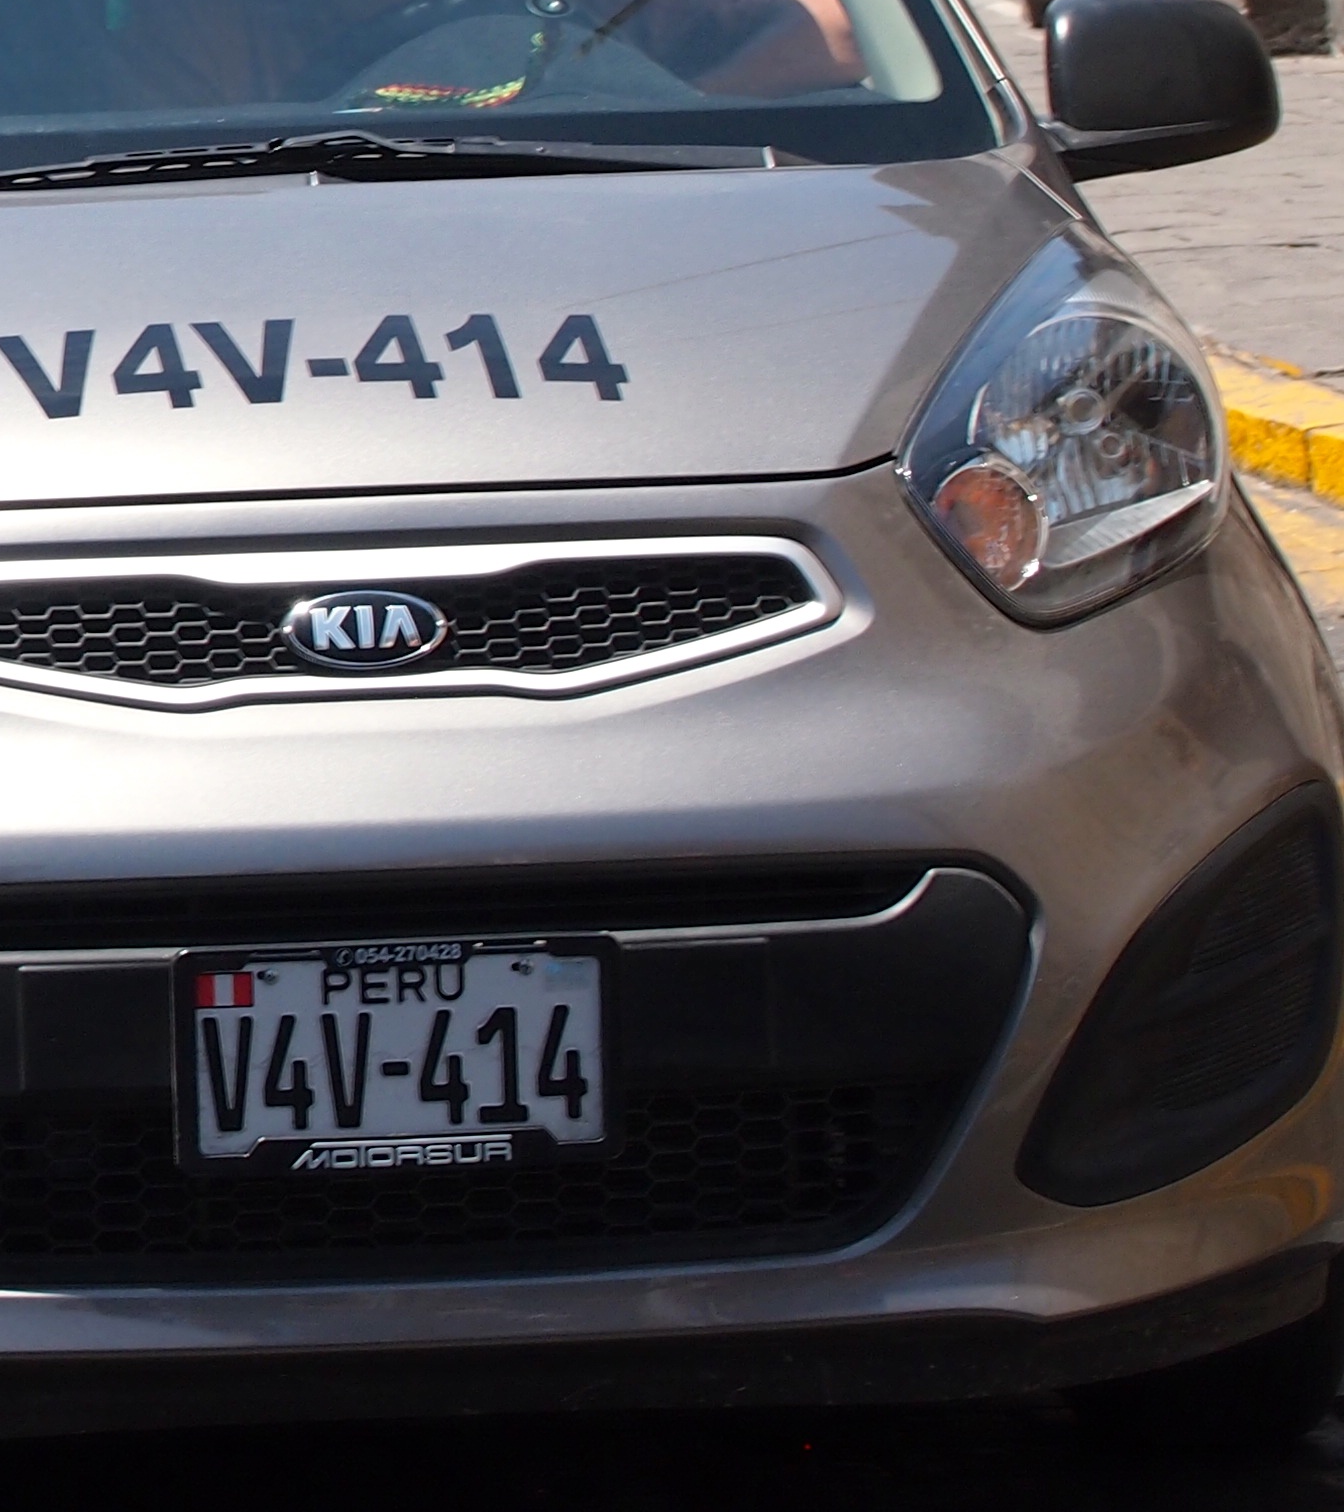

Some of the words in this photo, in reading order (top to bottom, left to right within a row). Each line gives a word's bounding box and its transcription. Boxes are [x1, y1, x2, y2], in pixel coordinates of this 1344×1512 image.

[311, 604, 420, 651] KIA
[321, 964, 466, 1005] PERU
[202, 1004, 589, 1132] V4V-414
[291, 1134, 513, 1171] MOTORSUR
